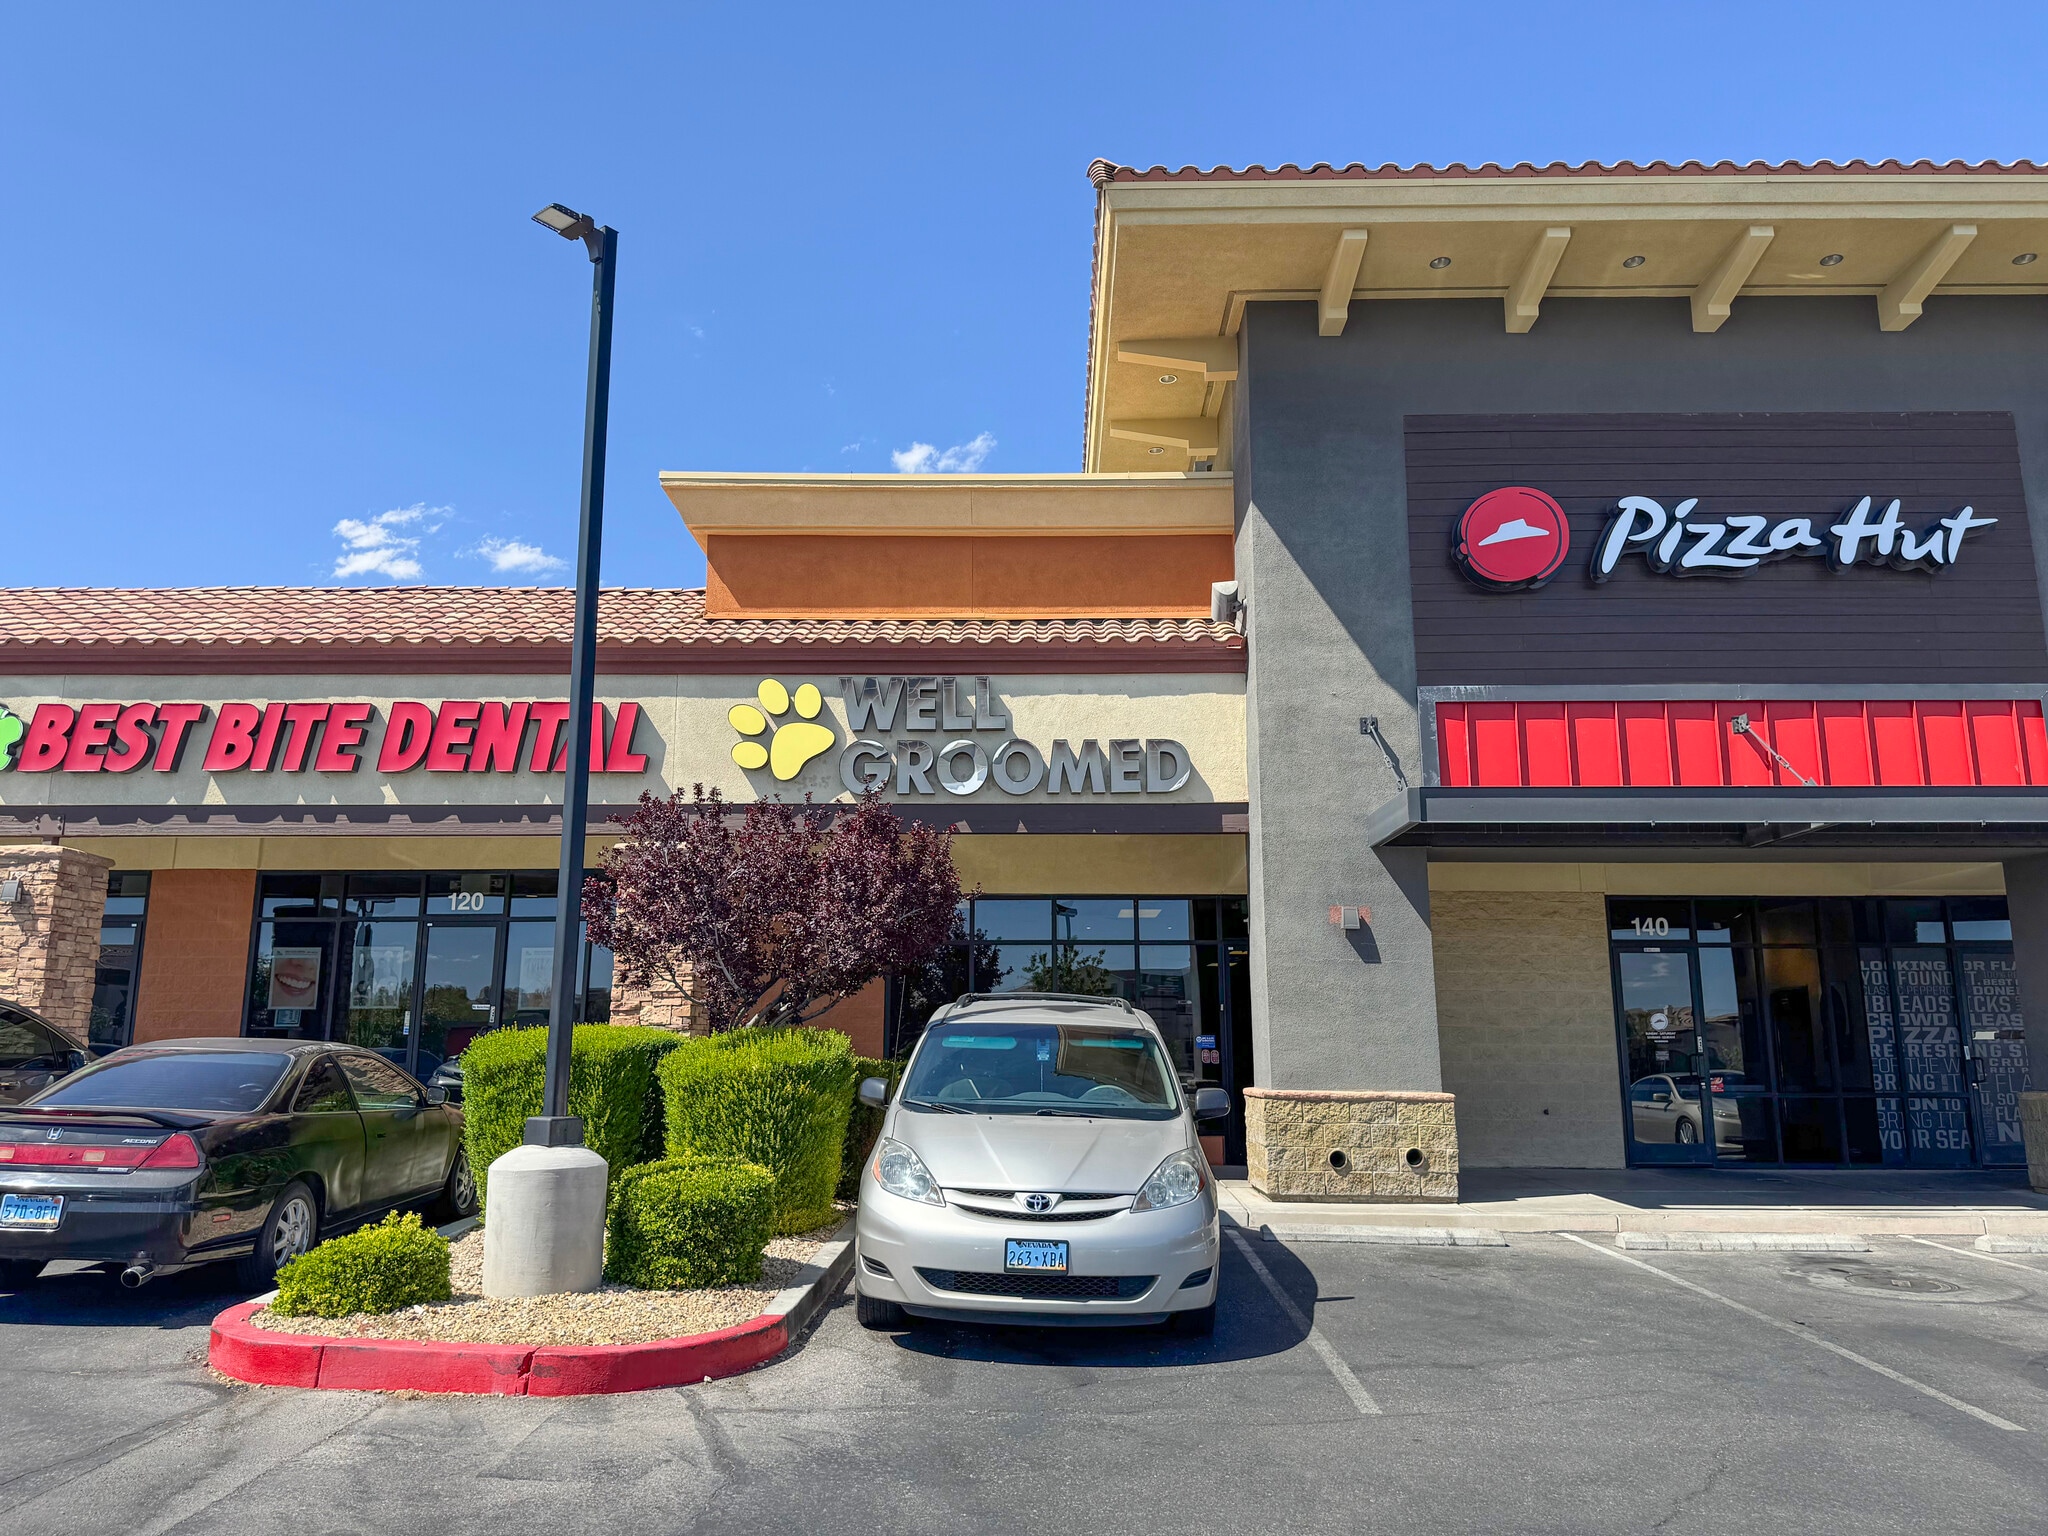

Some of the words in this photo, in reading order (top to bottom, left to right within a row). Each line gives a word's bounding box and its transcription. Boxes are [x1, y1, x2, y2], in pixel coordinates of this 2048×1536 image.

[1600, 495, 1821, 575] Pizza
[1829, 495, 1999, 565] Hut
[838, 676, 1006, 732] WELL
[17, 702, 208, 774] BEST
[202, 702, 374, 774] BITE
[839, 738, 1191, 796] GROOMED
[448, 892, 484, 911] 120
[1631, 917, 1669, 936] 140
[1898, 971, 1953, 986] FOUND
[1904, 1058, 1940, 1073] THE
[1942, 1098, 1961, 1111] TO
